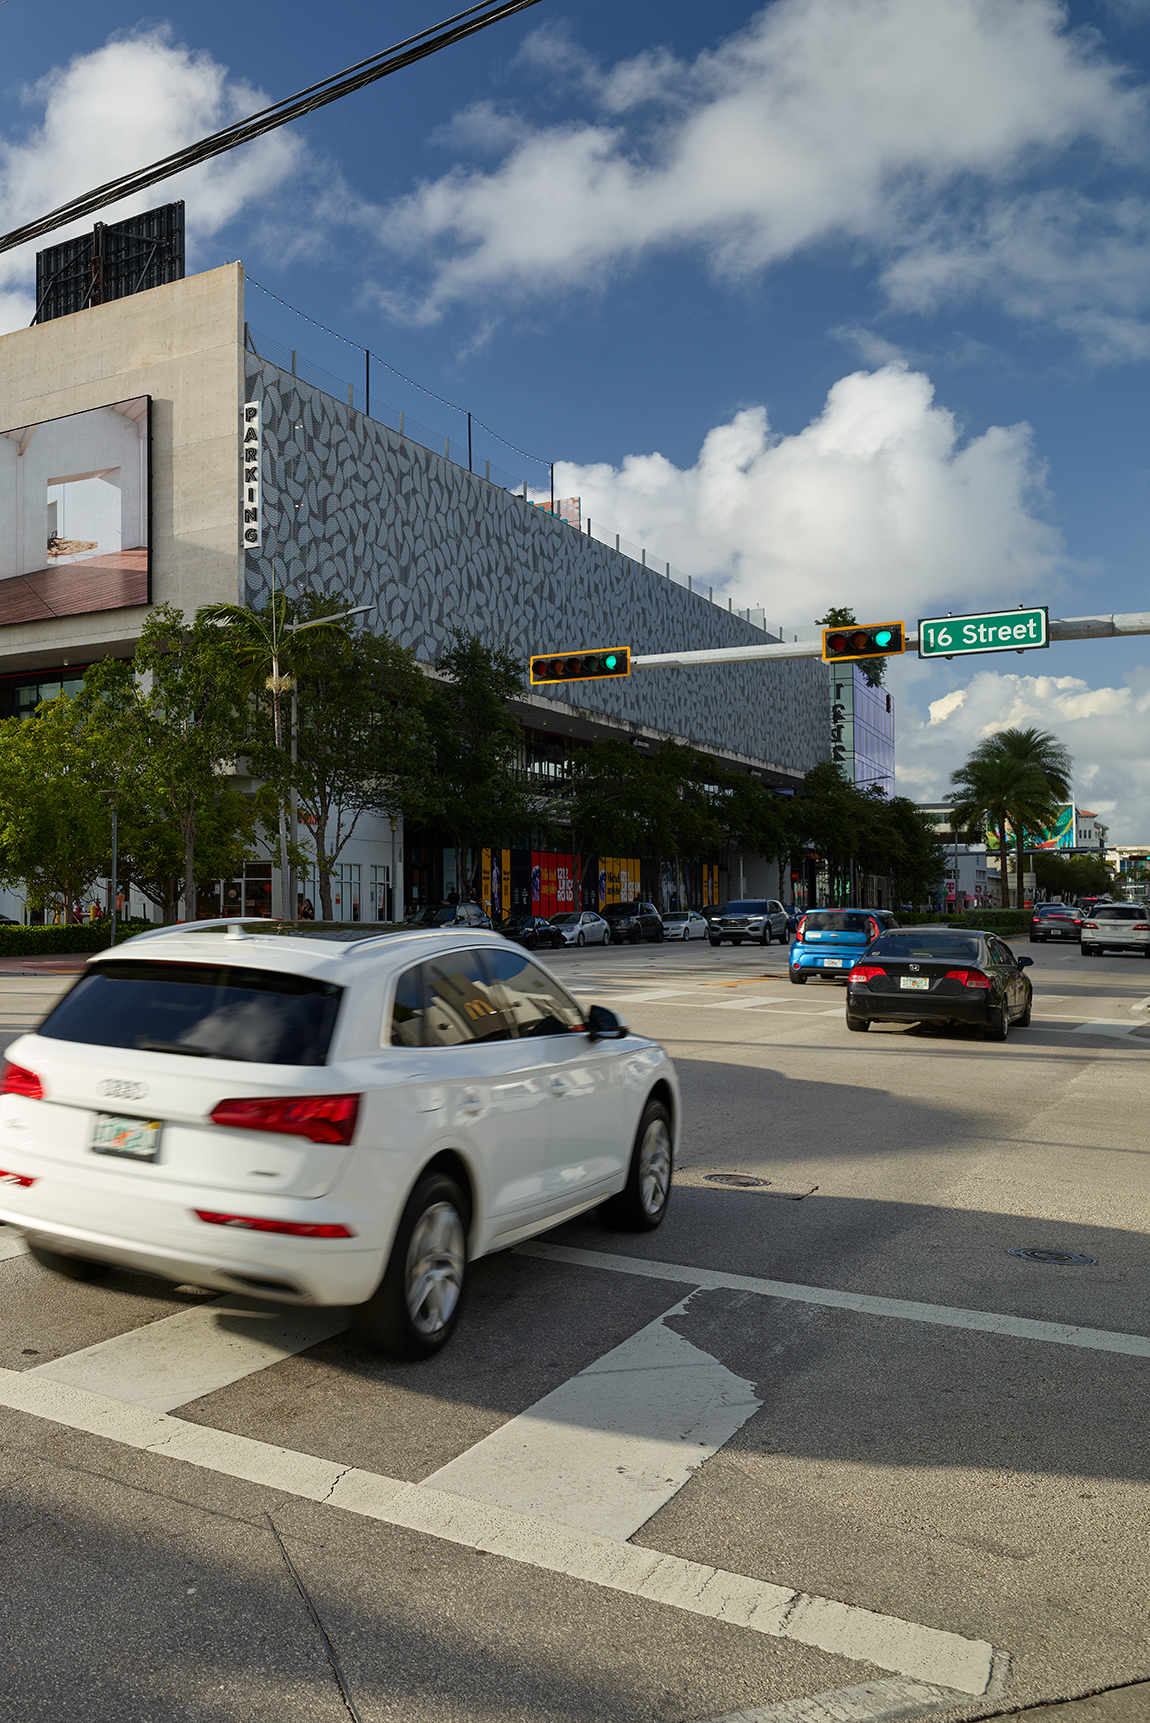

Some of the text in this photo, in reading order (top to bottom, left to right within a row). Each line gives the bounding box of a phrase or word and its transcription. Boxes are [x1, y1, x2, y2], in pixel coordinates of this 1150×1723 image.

[244, 406, 258, 543] PARKING
[928, 618, 1037, 647] 16 Street
